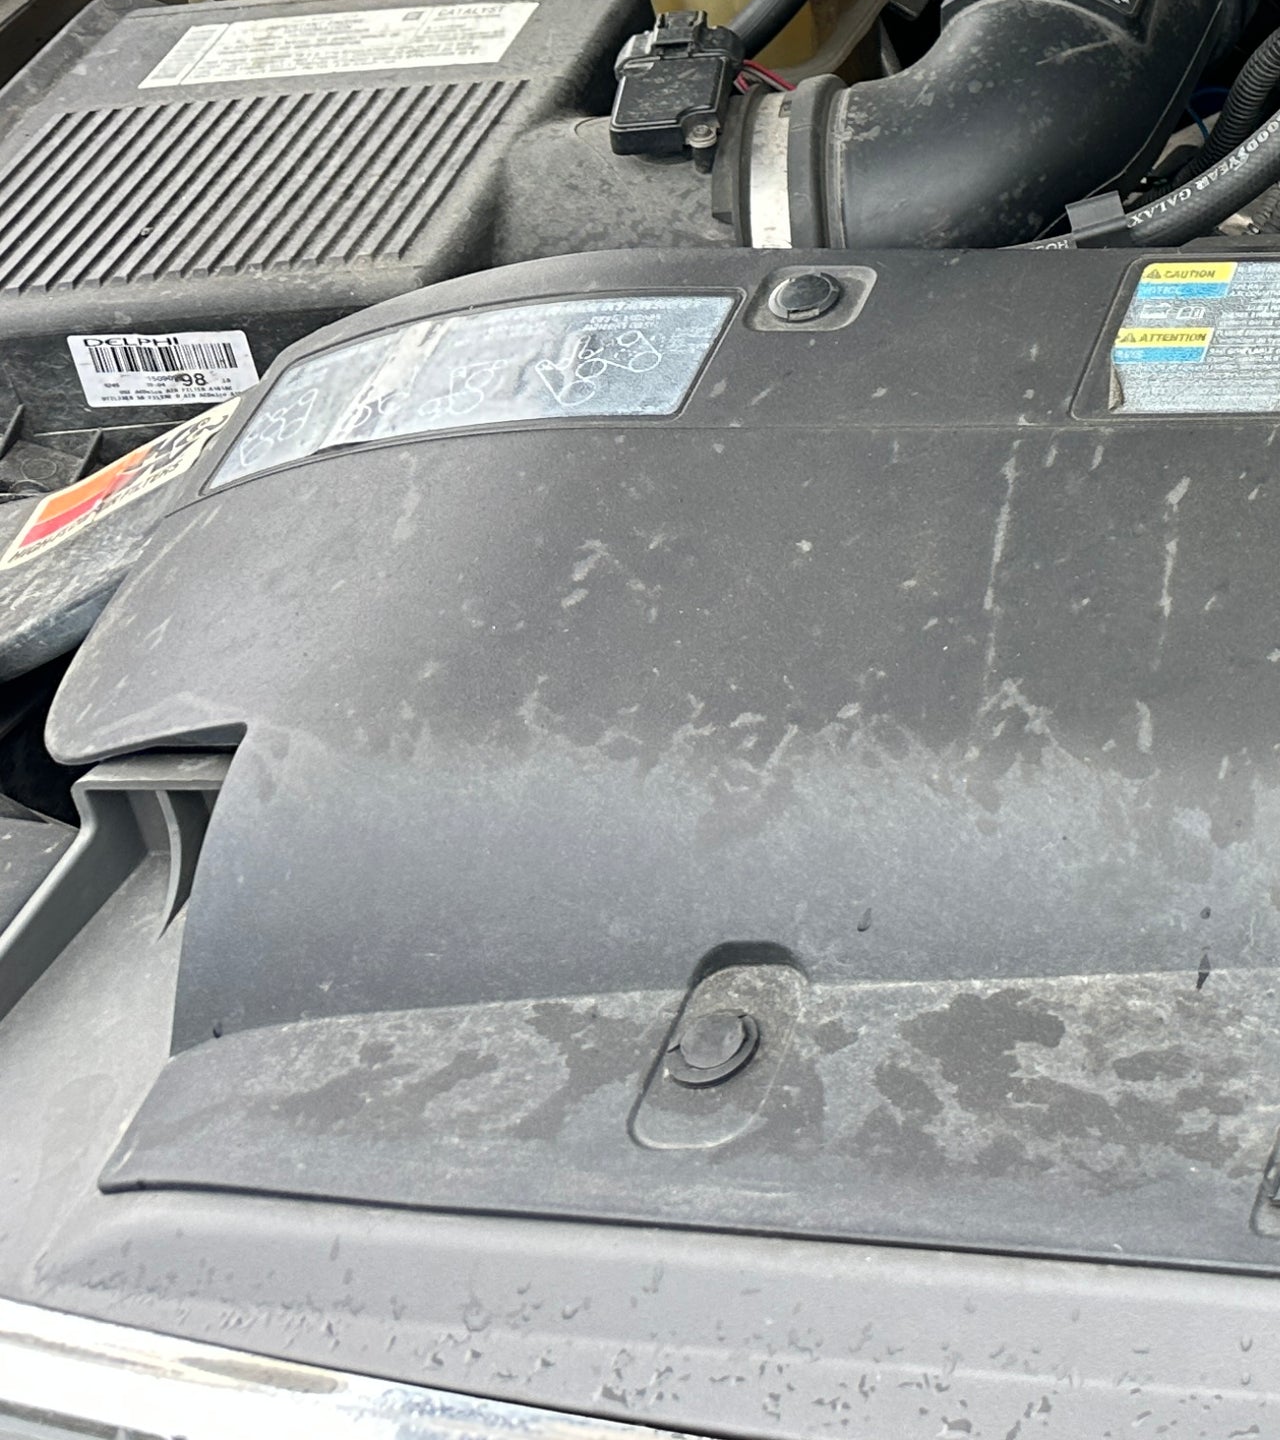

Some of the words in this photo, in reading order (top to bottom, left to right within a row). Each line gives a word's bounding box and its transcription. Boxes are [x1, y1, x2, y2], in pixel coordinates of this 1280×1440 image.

[1163, 268, 1216, 280] CAUTION
[83, 337, 179, 347] DELPHI
[1139, 333, 1207, 344] ATTENTION
